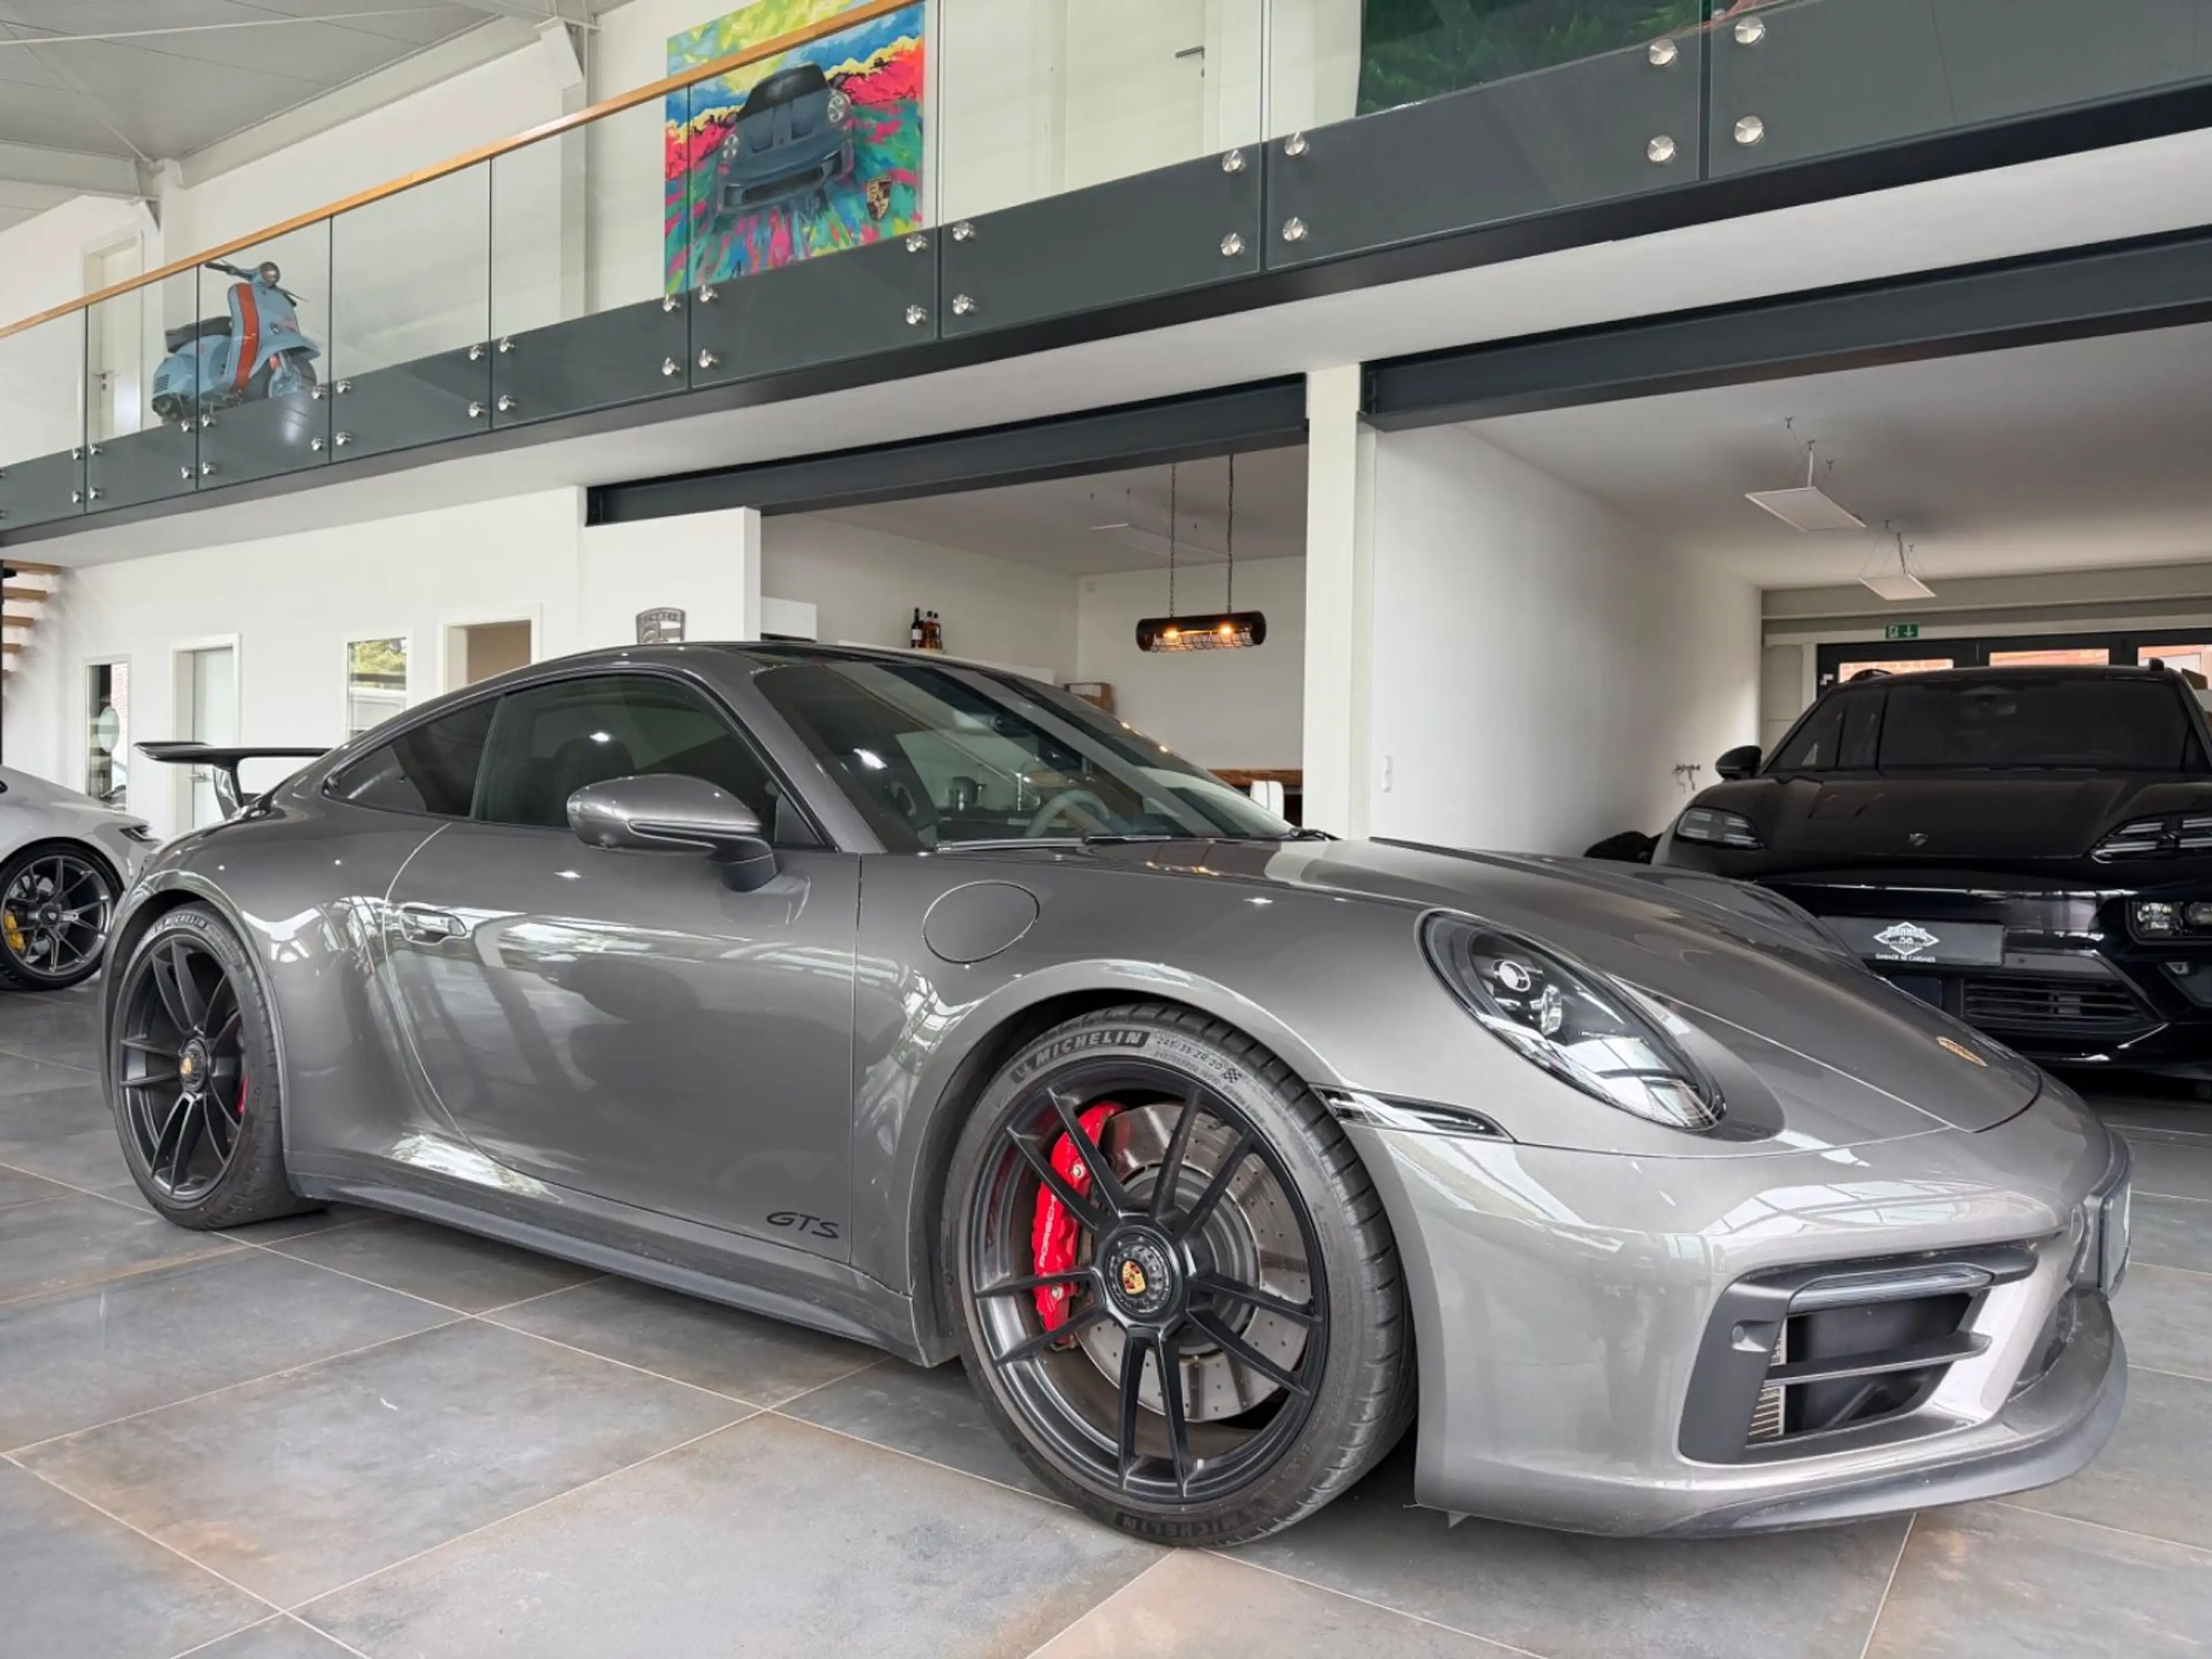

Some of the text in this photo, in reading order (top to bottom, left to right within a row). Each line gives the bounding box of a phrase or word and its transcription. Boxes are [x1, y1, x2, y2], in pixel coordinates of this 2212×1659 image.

[1036, 1031, 1142, 1065] MICHELIN
[1193, 1050, 1209, 1062] ZR
[1208, 1058, 1224, 1070] 20
[766, 1211, 839, 1238] GTS
